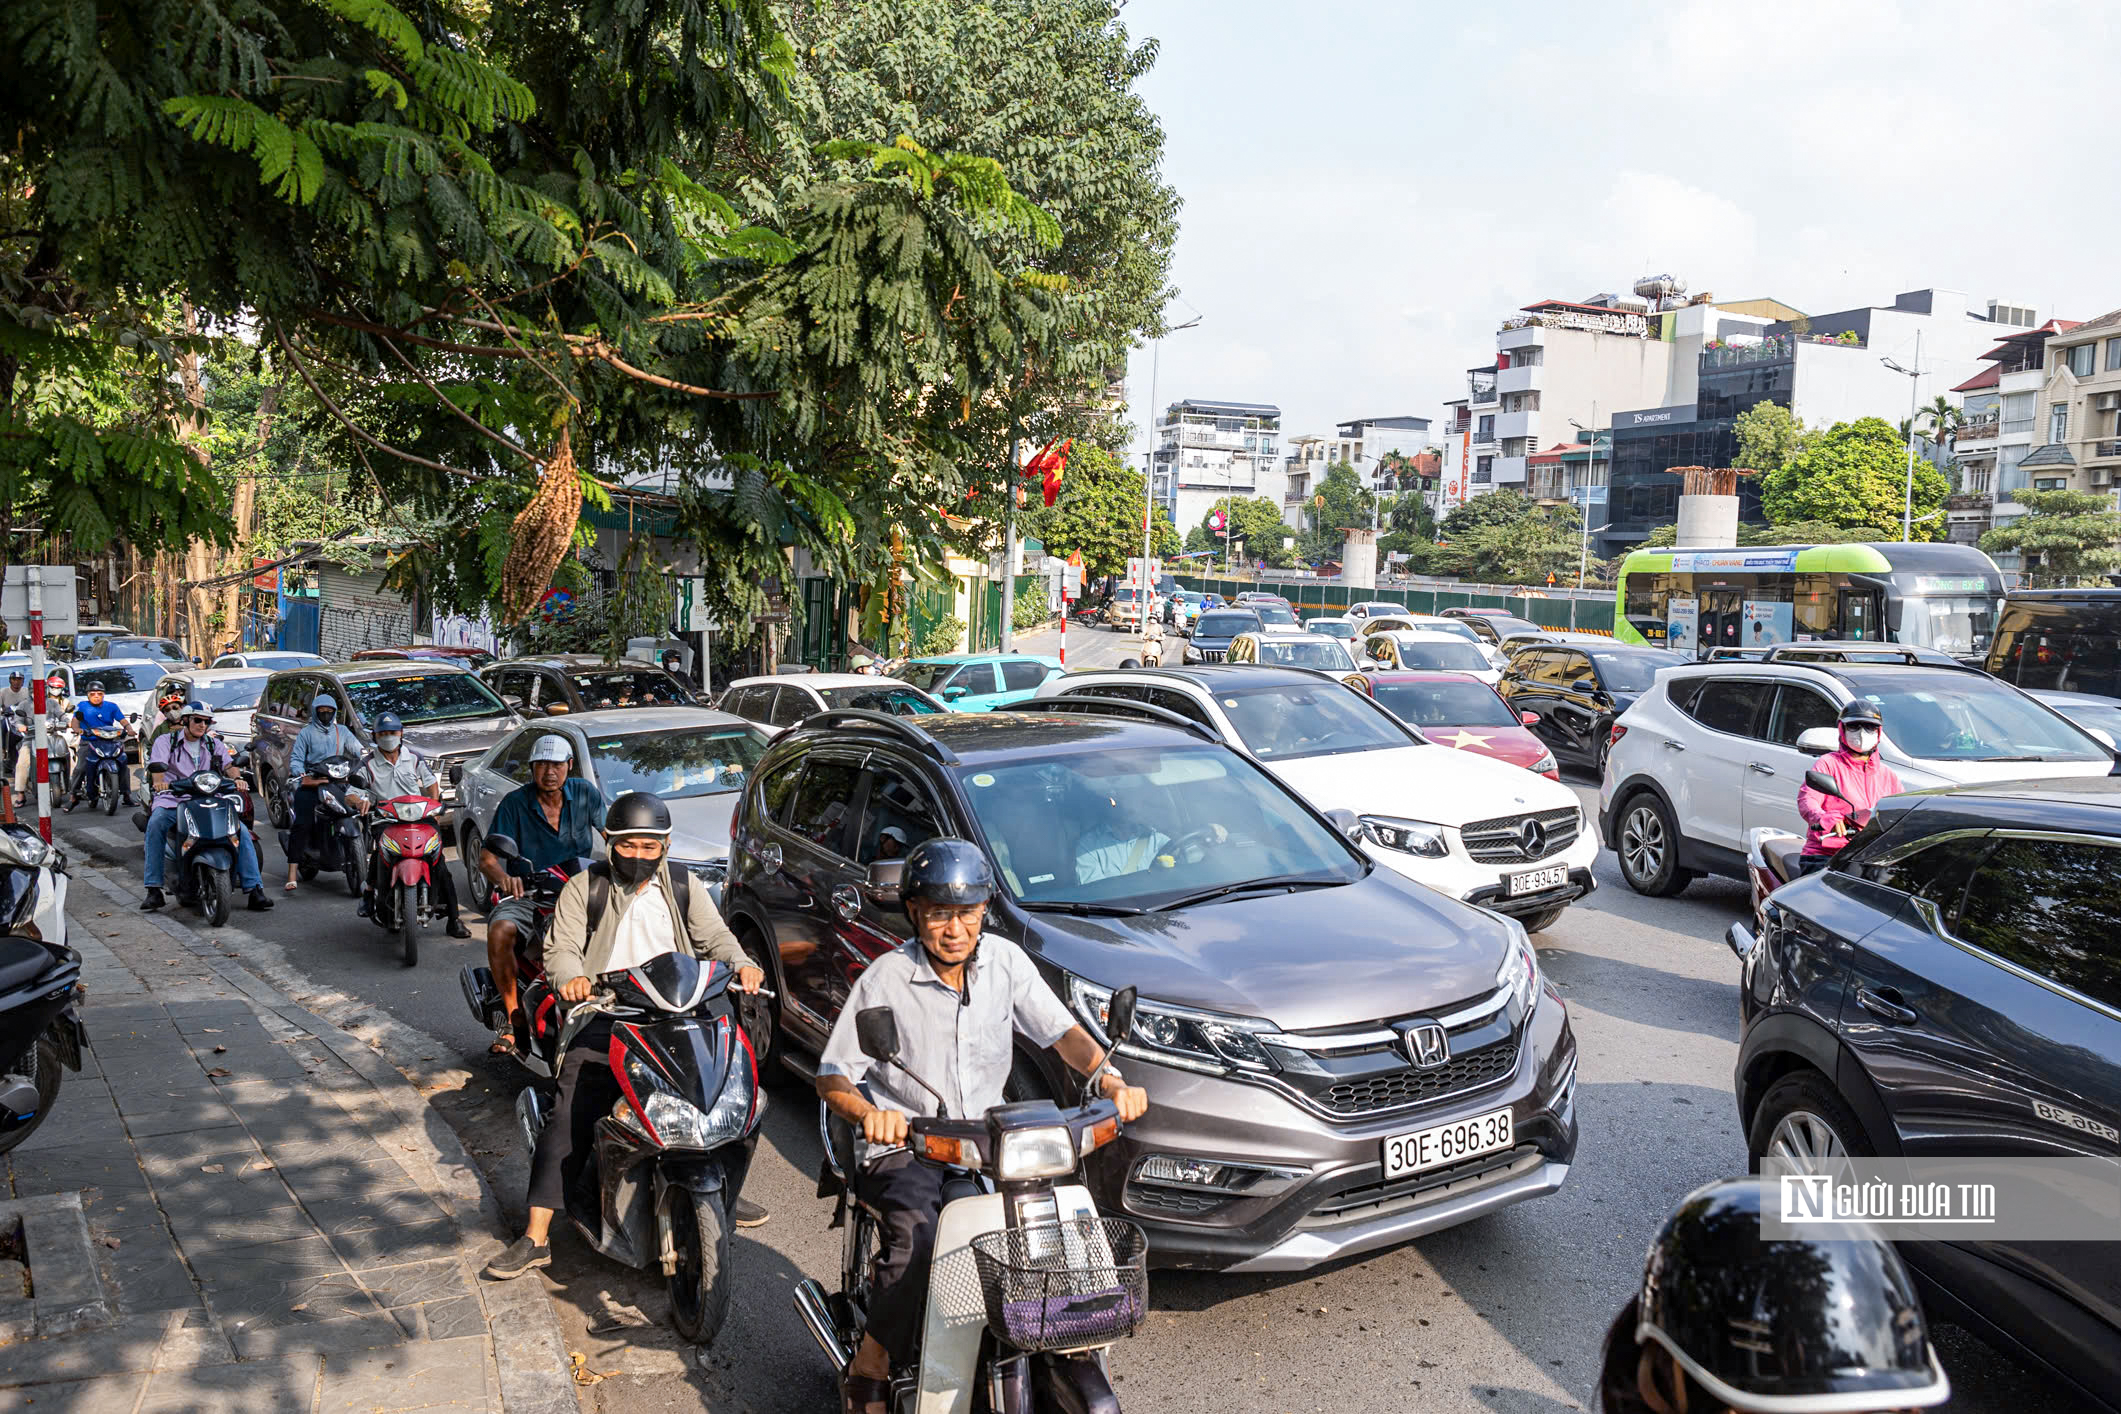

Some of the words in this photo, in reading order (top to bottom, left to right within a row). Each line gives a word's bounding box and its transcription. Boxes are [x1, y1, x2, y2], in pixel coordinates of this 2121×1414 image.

[1643, 412, 1671, 422] APARTMENT
[1513, 867, 1566, 892] 30E-934.57
[1391, 1114, 1509, 1170] 30E-696.38
